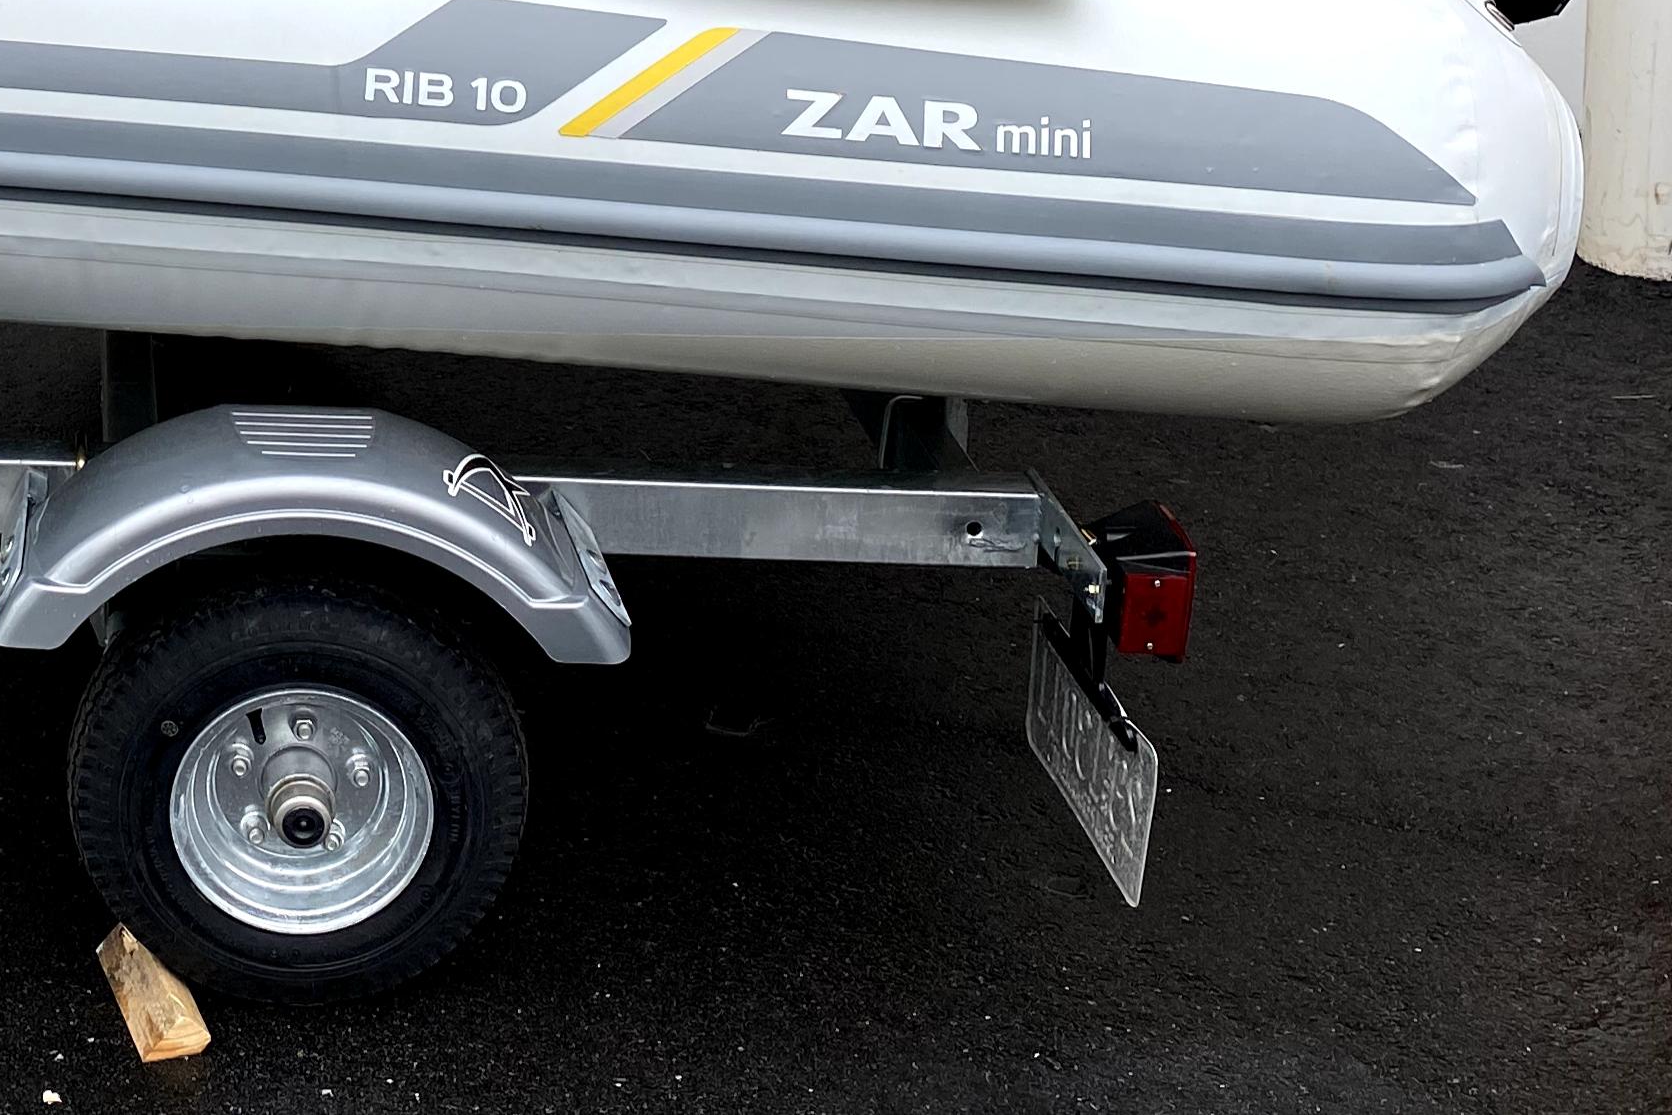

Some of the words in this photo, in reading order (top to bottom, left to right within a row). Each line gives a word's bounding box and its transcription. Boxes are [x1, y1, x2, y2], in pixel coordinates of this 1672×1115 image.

[364, 67, 454, 107] RIB
[470, 77, 527, 114] 10
[781, 88, 982, 151] ZAR
[996, 117, 1092, 159] mini
